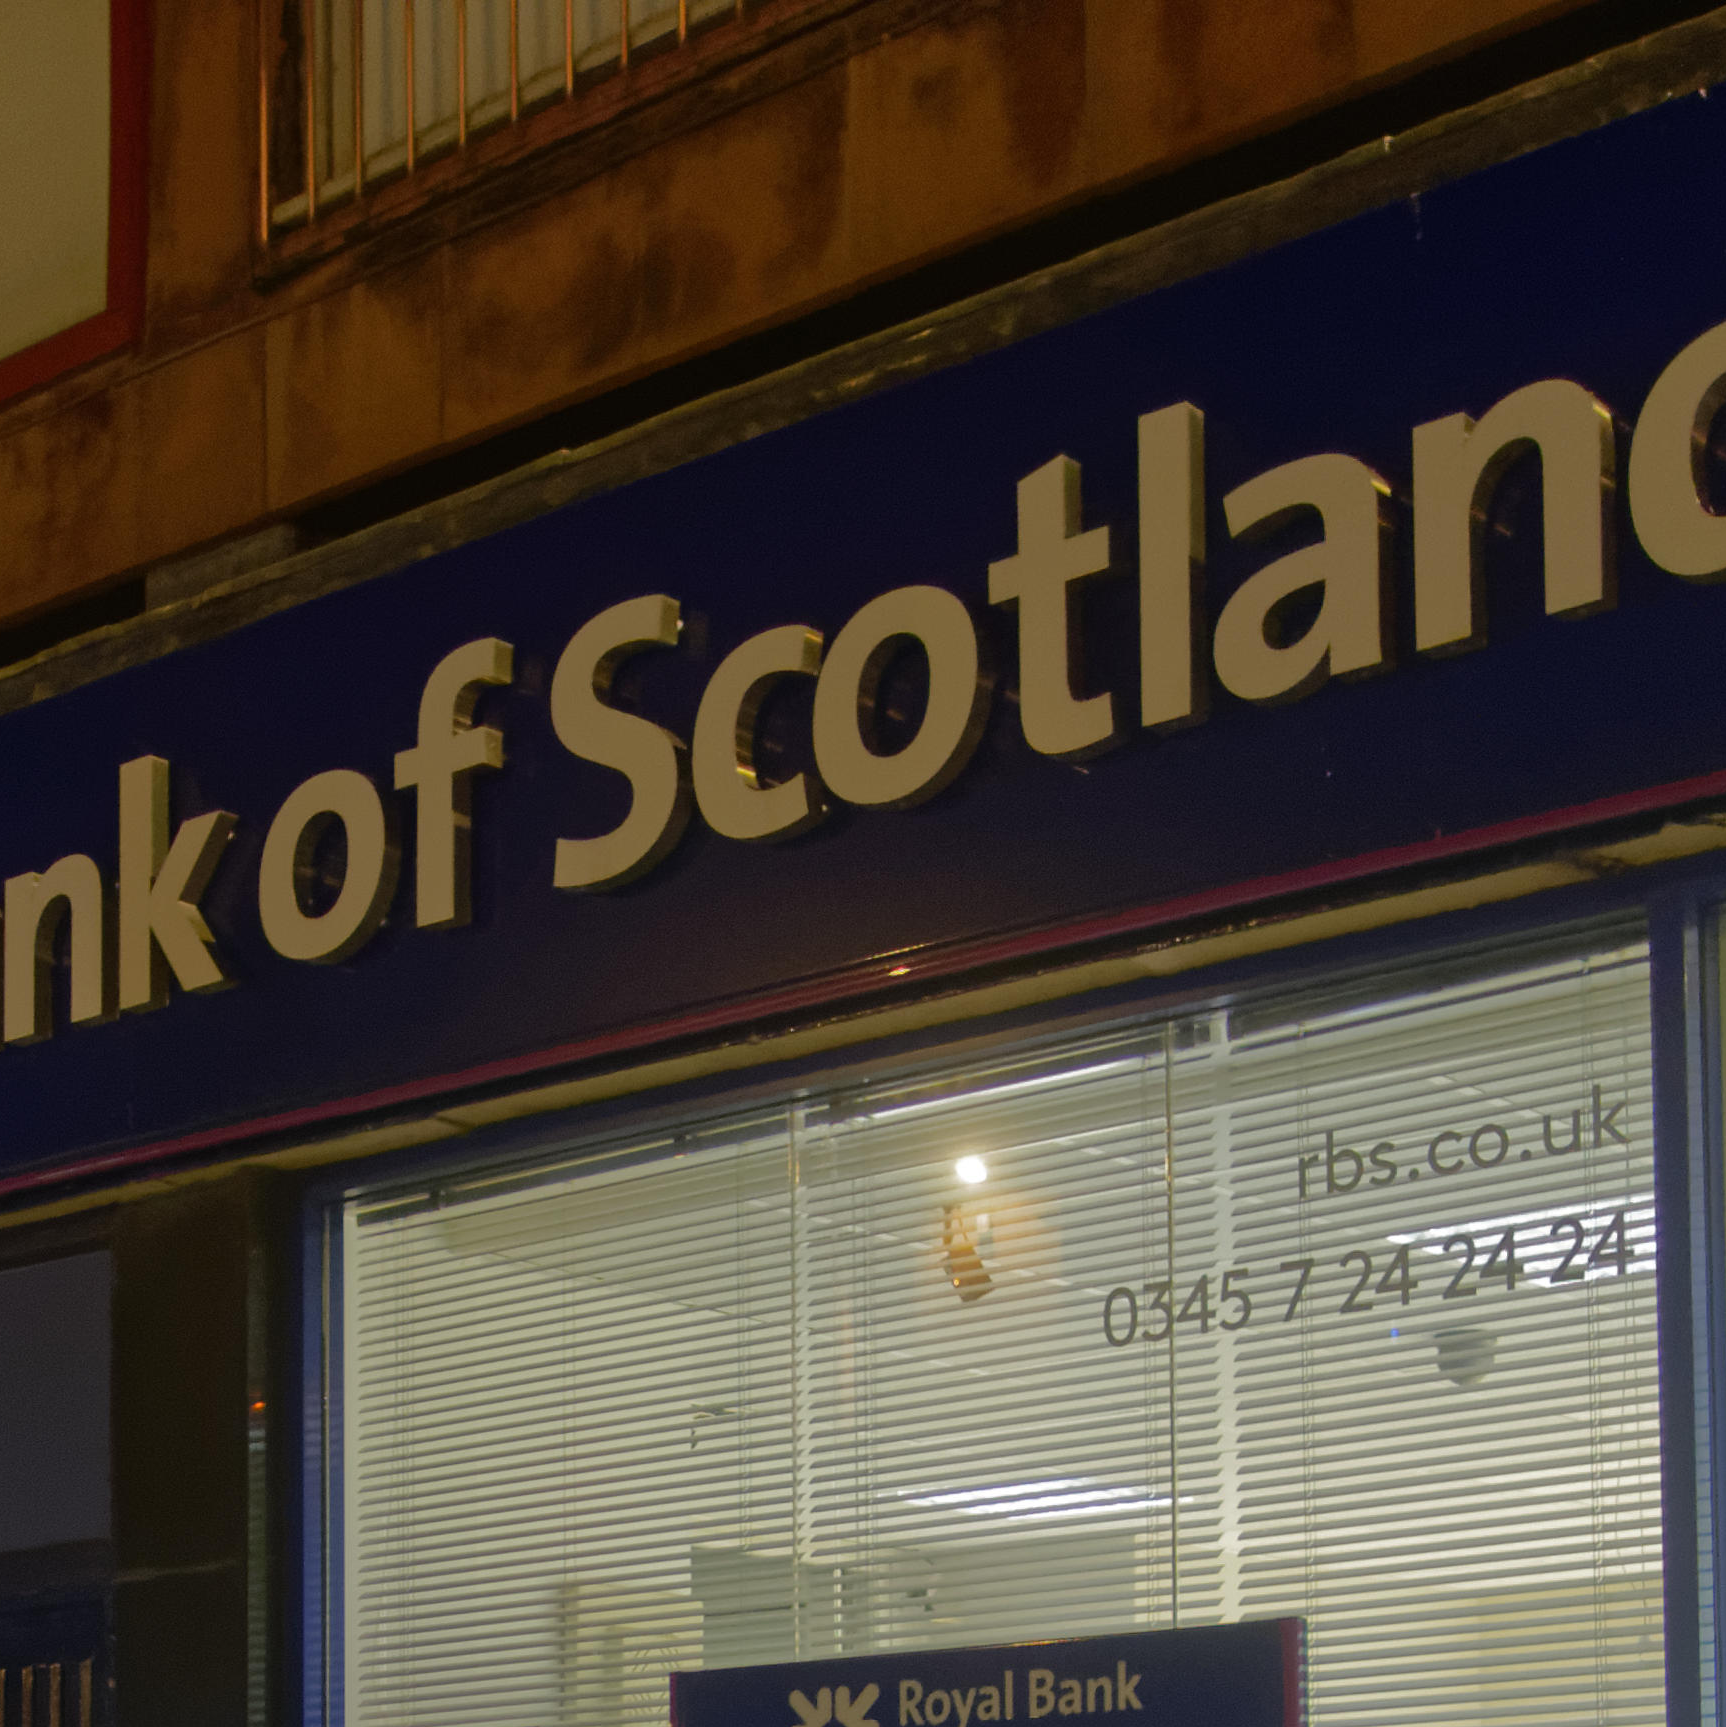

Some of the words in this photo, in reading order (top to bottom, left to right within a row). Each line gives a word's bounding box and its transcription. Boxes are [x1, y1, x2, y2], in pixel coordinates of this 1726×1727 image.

[258, 636, 514, 964] of
[1297, 1083, 1633, 1199] rbs.co.uk
[1101, 1267, 1254, 1348] 0345
[1279, 1258, 1315, 1323] 7
[1338, 1244, 1419, 1315] 24
[1441, 1226, 1525, 1301] 24
[1549, 1210, 1635, 1285] 24
[1028, 1660, 1144, 1719] Bank
